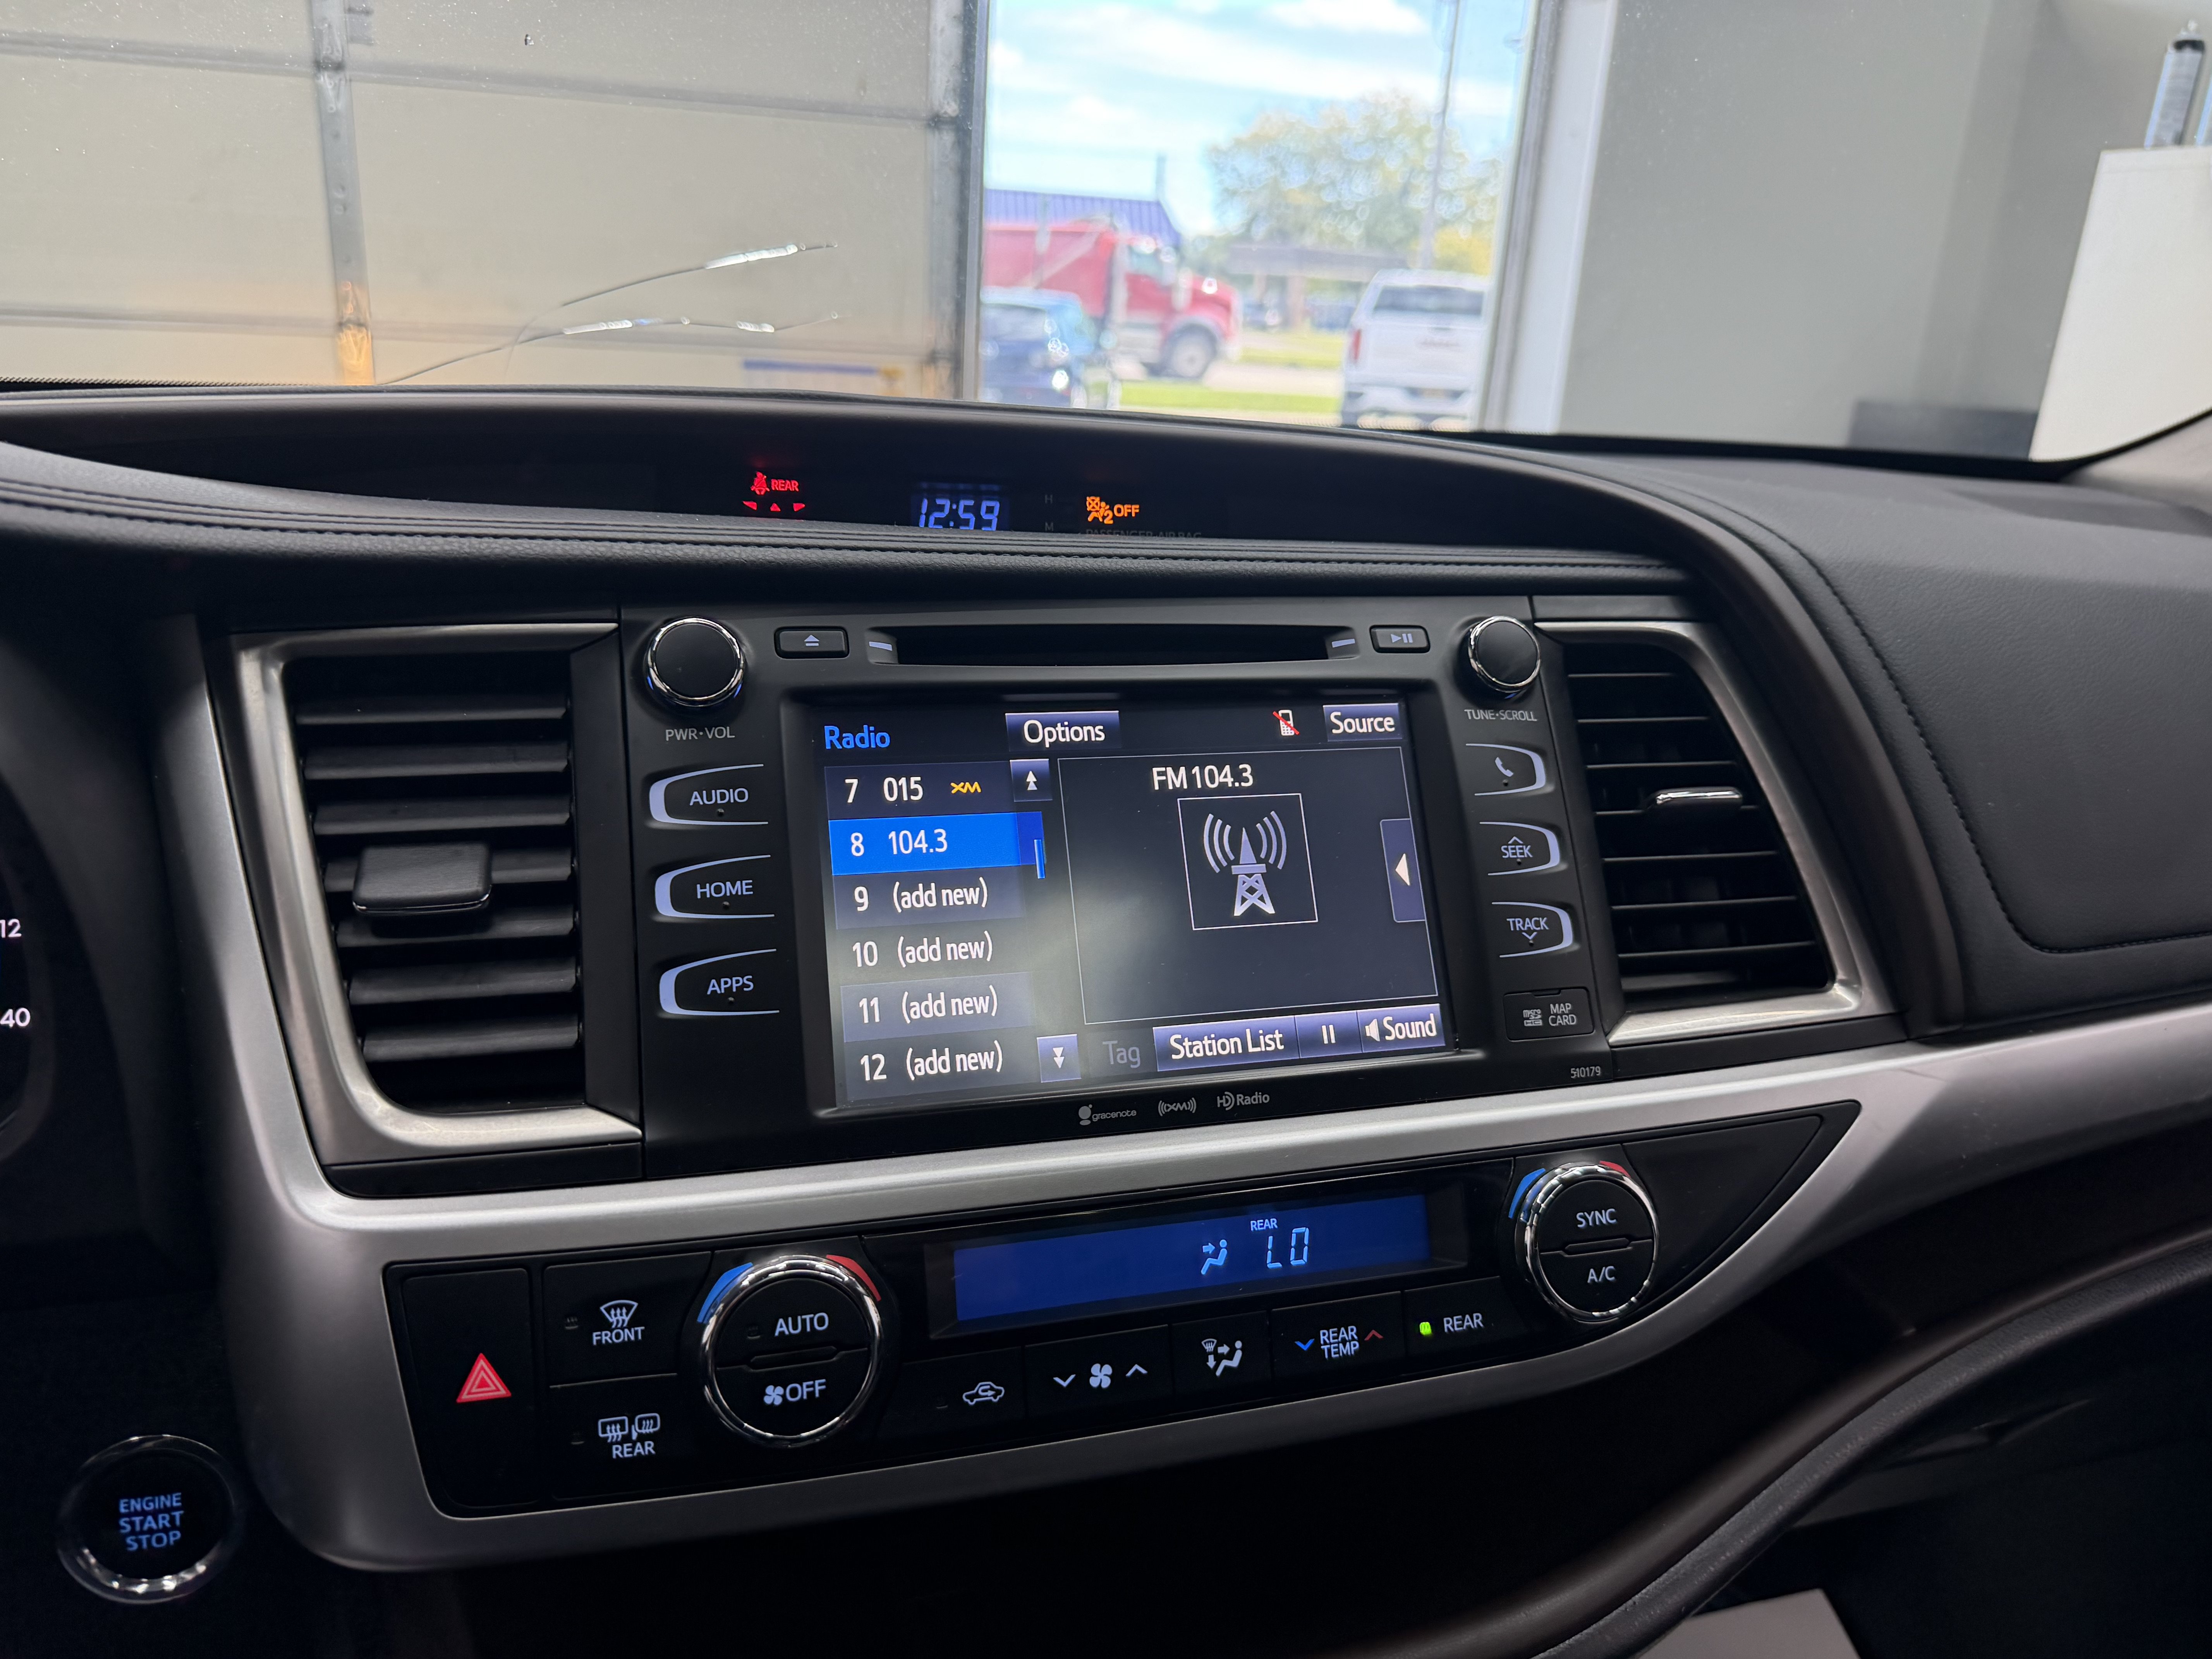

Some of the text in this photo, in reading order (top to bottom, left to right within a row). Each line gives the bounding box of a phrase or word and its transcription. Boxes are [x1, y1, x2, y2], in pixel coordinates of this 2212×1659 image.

[771, 479, 799, 491] REAR
[1045, 495, 1053, 503] H
[919, 498, 1000, 531] 12:59
[1114, 504, 1139, 517] OFF
[1045, 522, 1054, 531] M
[1329, 711, 1395, 734] Source
[824, 725, 891, 749] Radio
[1024, 719, 1106, 748] Options
[1151, 763, 1254, 790] FM 104.3
[689, 788, 749, 806] AUDIO
[845, 776, 982, 803] 7 015 XM
[850, 828, 948, 857] 8 104.3
[1501, 845, 1533, 858] SEEK
[696, 880, 753, 899] HOME
[854, 877, 988, 913] 9 (add new)
[1506, 917, 1549, 931] TRACK
[852, 930, 993, 968] 10 (add new)
[706, 975, 754, 995] APPS
[859, 984, 998, 1024] 11 (add new)
[1550, 1003, 1571, 1014] MAP
[1384, 1012, 1437, 1041] Sound
[1549, 1014, 1577, 1026] CARD
[1103, 1039, 1140, 1069] Tag
[1170, 1028, 1285, 1060] Station List
[860, 1040, 1003, 1081] 12 (add new)
[1237, 1092, 1270, 1106] Radio
[1092, 1109, 1137, 1121] gracenote
[1250, 1218, 1278, 1231] REAR
[1576, 1208, 1617, 1229] SYNC
[1587, 1266, 1616, 1284] A/C
[775, 1312, 829, 1337] AUTO
[1443, 1312, 1484, 1333] REAR
[592, 1326, 645, 1346] FRONT
[1319, 1325, 1358, 1345] REAR
[1321, 1341, 1360, 1360] TEMP
[785, 1379, 826, 1403] OFF
[612, 1441, 656, 1459] REAR
[119, 1492, 182, 1513] ENGINE
[118, 1510, 184, 1534] START
[125, 1530, 181, 1551] STOP
